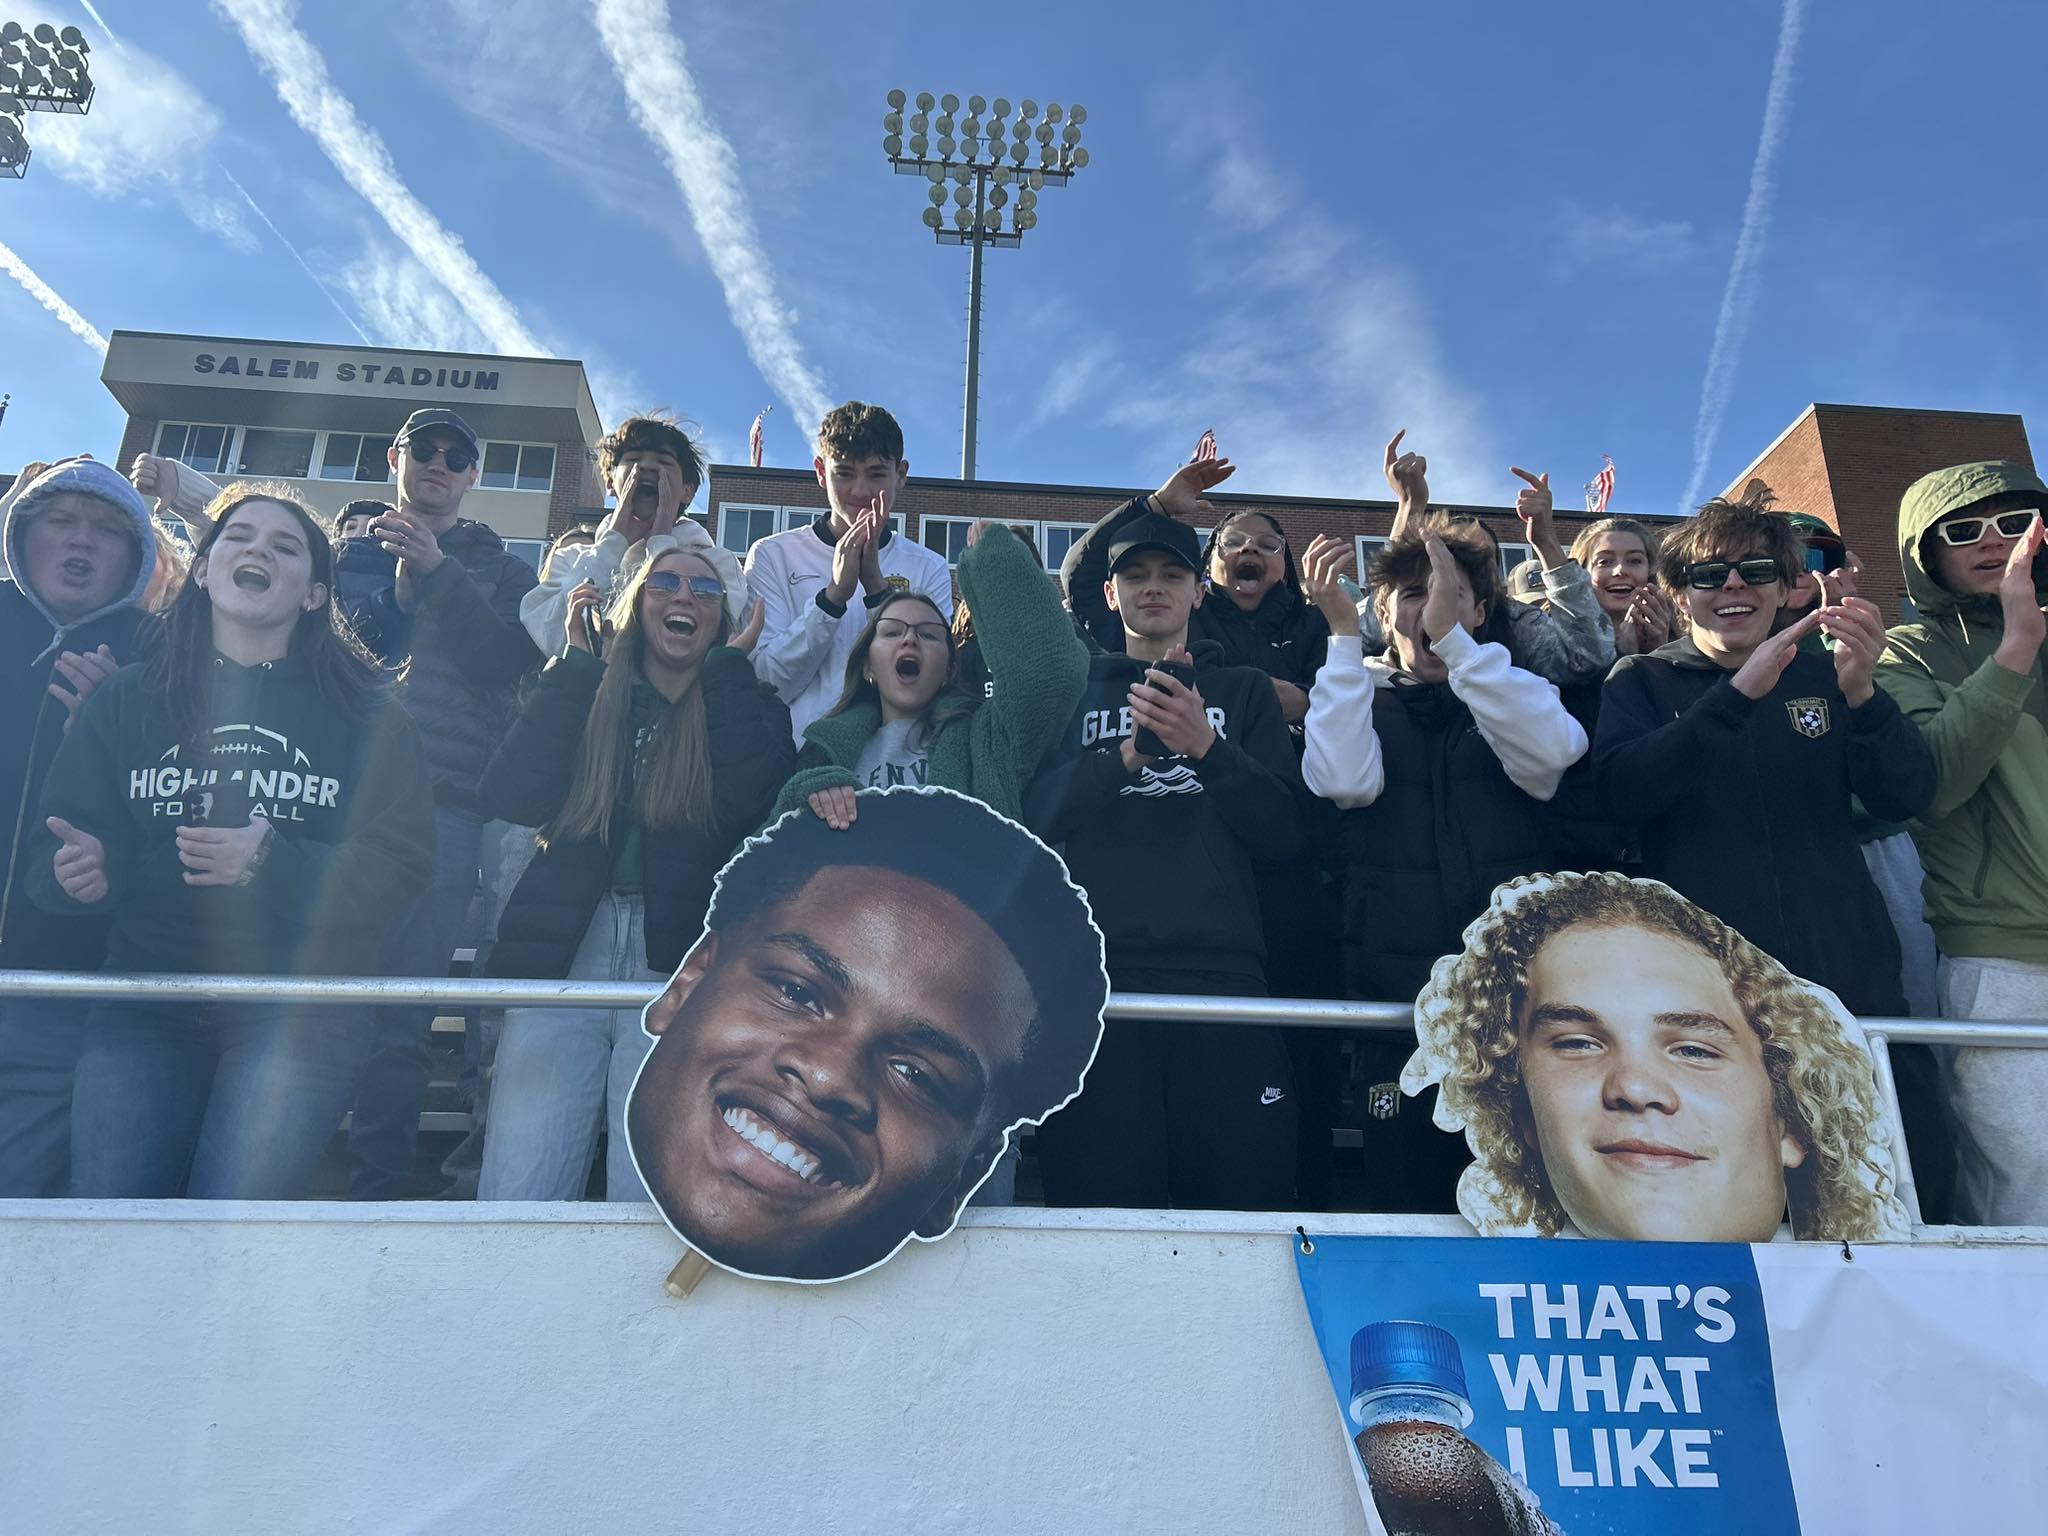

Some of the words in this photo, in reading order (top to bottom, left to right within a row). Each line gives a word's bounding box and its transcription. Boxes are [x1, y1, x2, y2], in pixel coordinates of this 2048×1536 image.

[194, 353, 319, 380] SALEM
[336, 363, 499, 391] STADIUM
[1081, 706, 1227, 746] GLER
[153, 801, 305, 822] FOALL
[1264, 1086, 1282, 1098] NIKE
[1478, 1282, 1736, 1343] THAT'S
[1488, 1353, 1710, 1414] WHAT
[1506, 1427, 1528, 1487] I
